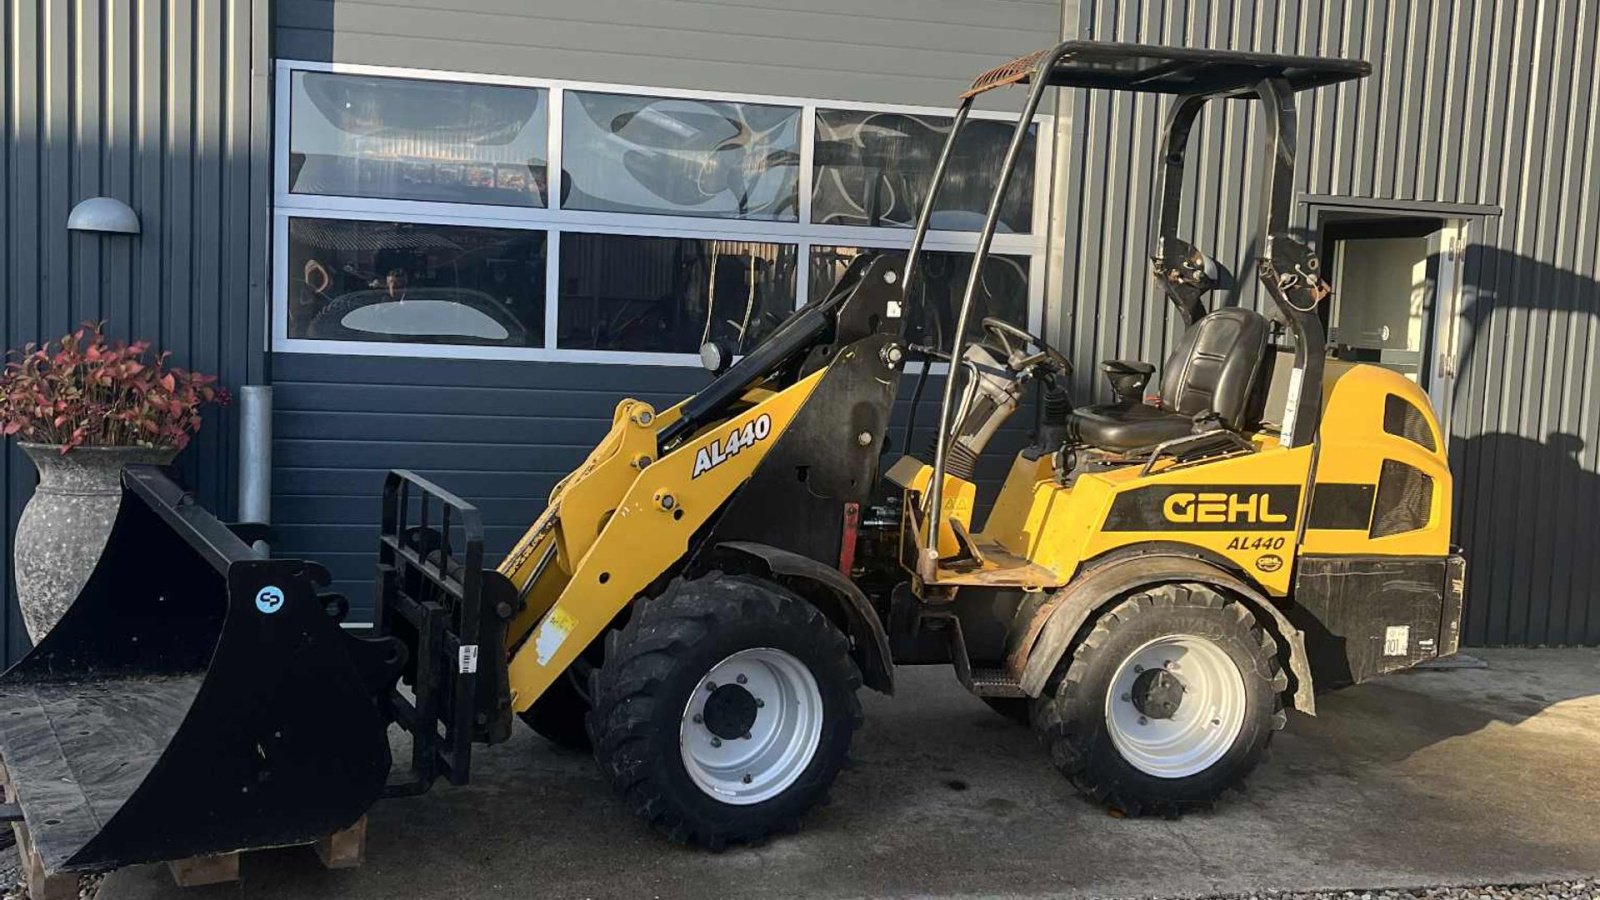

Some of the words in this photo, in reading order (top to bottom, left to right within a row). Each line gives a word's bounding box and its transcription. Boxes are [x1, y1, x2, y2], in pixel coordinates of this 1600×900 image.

[692, 413, 771, 479] AL440
[1163, 492, 1287, 523] GEHL
[1226, 536, 1285, 550] AL440
